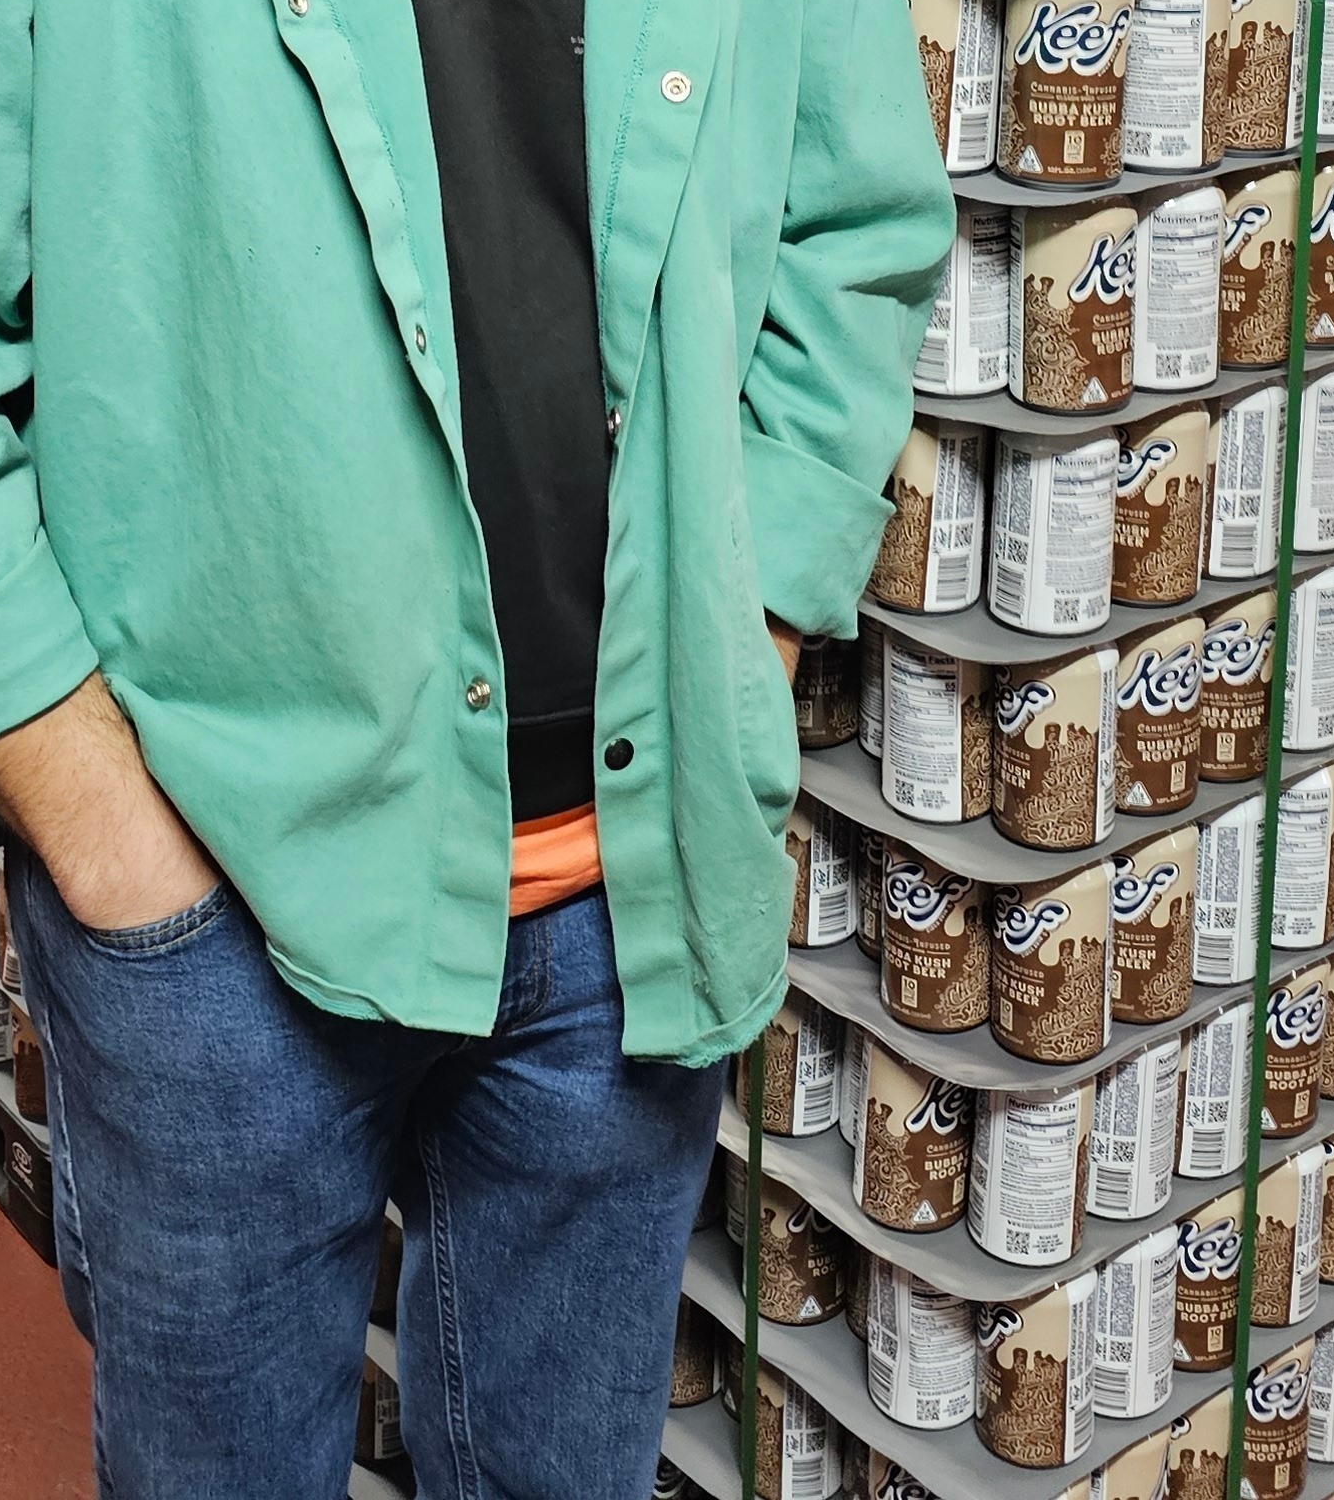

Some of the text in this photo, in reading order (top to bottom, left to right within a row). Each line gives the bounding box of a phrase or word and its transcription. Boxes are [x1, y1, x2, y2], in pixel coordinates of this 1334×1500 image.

[1189, 18, 1201, 28] 65
[1014, 1, 1133, 76] Keef
[1029, 99, 1116, 115] BUBBA KUSH
[1033, 113, 1112, 127] ROOT BEER
[1068, 135, 1082, 144] 10
[1233, 705, 1265, 719] KUSH
[1231, 716, 1261, 729] BEER
[1137, 736, 1181, 752] BUBBA
[1220, 736, 1233, 744] 10
[1142, 748, 1180, 762] ROOT
[1173, 765, 1184, 774] 10
[915, 955, 951, 968] KUSH
[913, 963, 946, 979] BEER
[904, 977, 915, 989] 10
[1011, 980, 1045, 997] KUSH
[1009, 990, 1040, 1007] BEER
[1266, 980, 1326, 1049] Kee
[1265, 1069, 1307, 1081] BUBBA
[1269, 1079, 1305, 1090] ROOT
[1008, 1099, 1076, 1113] Nutrition Facts
